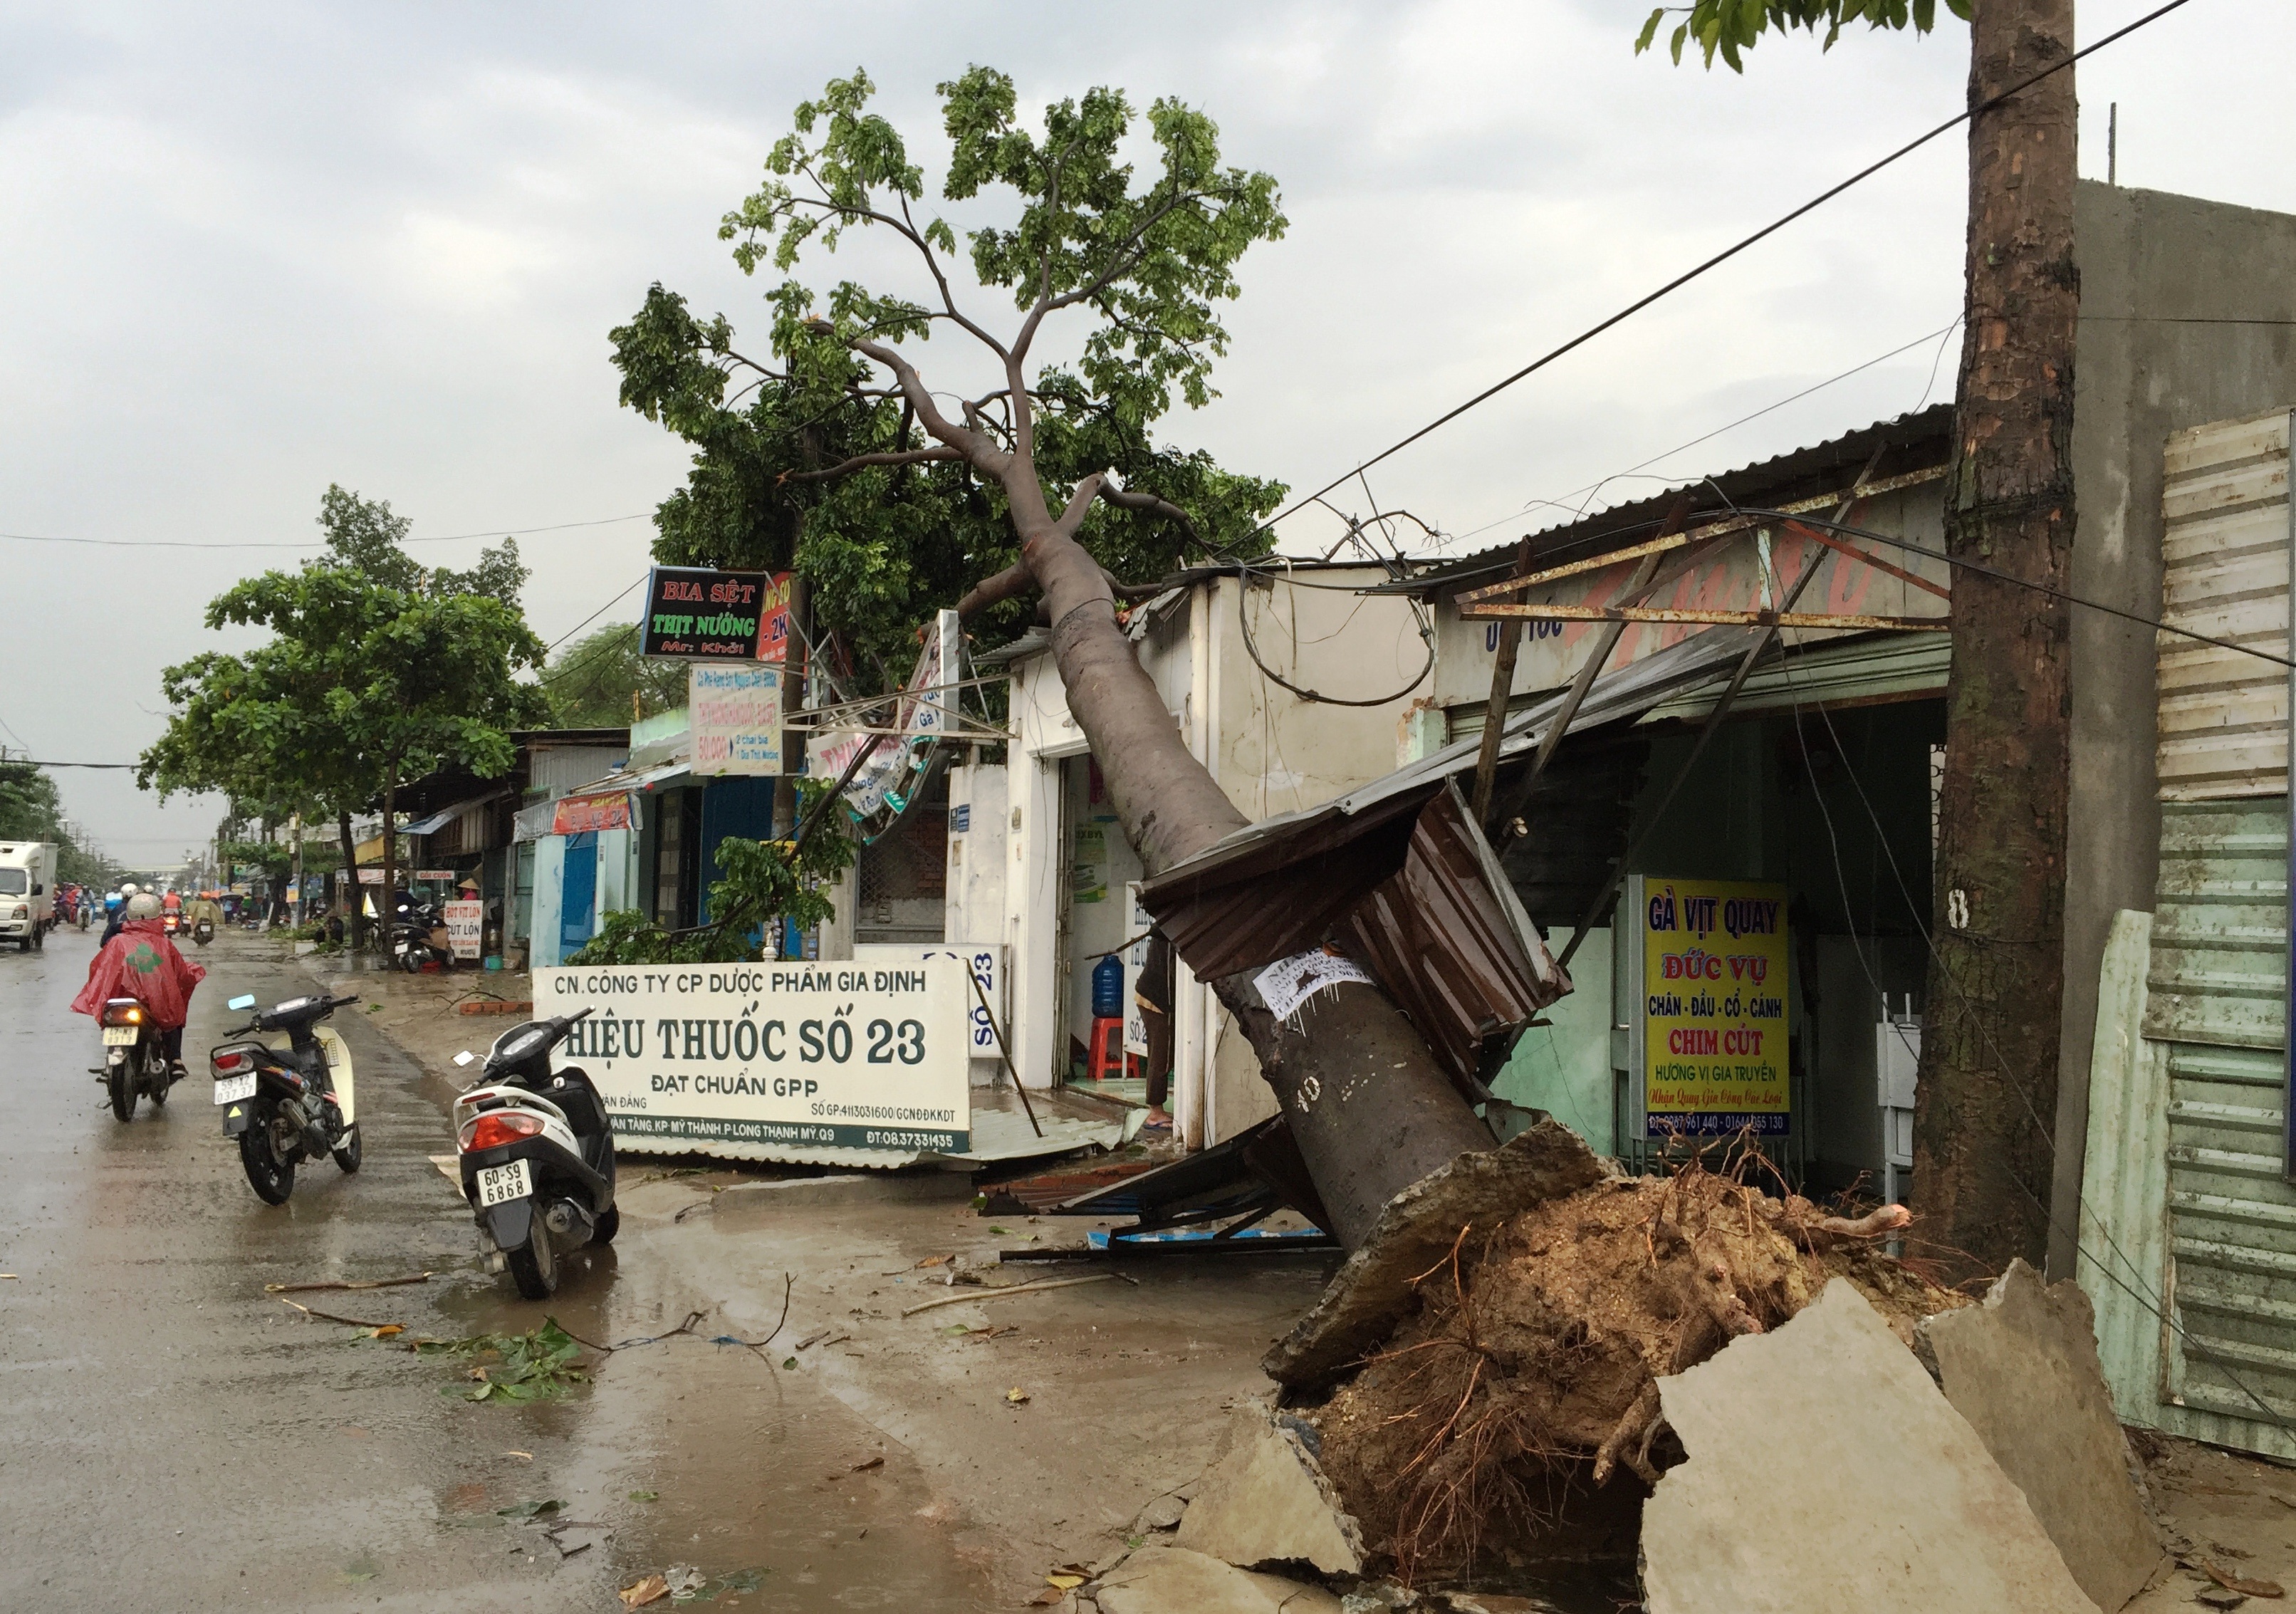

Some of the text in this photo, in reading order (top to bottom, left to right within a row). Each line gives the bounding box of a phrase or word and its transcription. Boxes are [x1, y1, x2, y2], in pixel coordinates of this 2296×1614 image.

[662, 578, 756, 608] BIA SỆT
[653, 612, 756, 639] THỊT NƯỚNG
[661, 641, 694, 652] Mr:
[701, 642, 745, 654] Khởi
[1649, 885, 1779, 940] GÀ VỊT QUAY
[645, 974, 670, 993] TY
[677, 974, 703, 993] CP
[710, 968, 763, 997] DƯỢC
[772, 964, 832, 992] PHẨM
[837, 972, 869, 992] GIA
[875, 970, 926, 997] ĐỊNH
[1661, 947, 1768, 986] ĐỨC VỤ
[1649, 991, 1681, 1017] CHÂN
[1691, 988, 1715, 1017] ĐẦU
[1724, 987, 1741, 1018] CỔ
[657, 1000, 786, 1062] THUỐC
[799, 1002, 854, 1064] SỐ
[867, 1019, 926, 1065] 23
[1669, 1022, 1764, 1056] CHIM CÚT
[652, 1067, 818, 1098] ĐẠT CHUẨN GPP
[1655, 1059, 1777, 1085] HƯƠNG VỊ GIA TRUYỀN
[1769, 1116, 1783, 1130] 130
[484, 1163, 521, 1187] 60-S9
[486, 1180, 524, 1202] 6868
